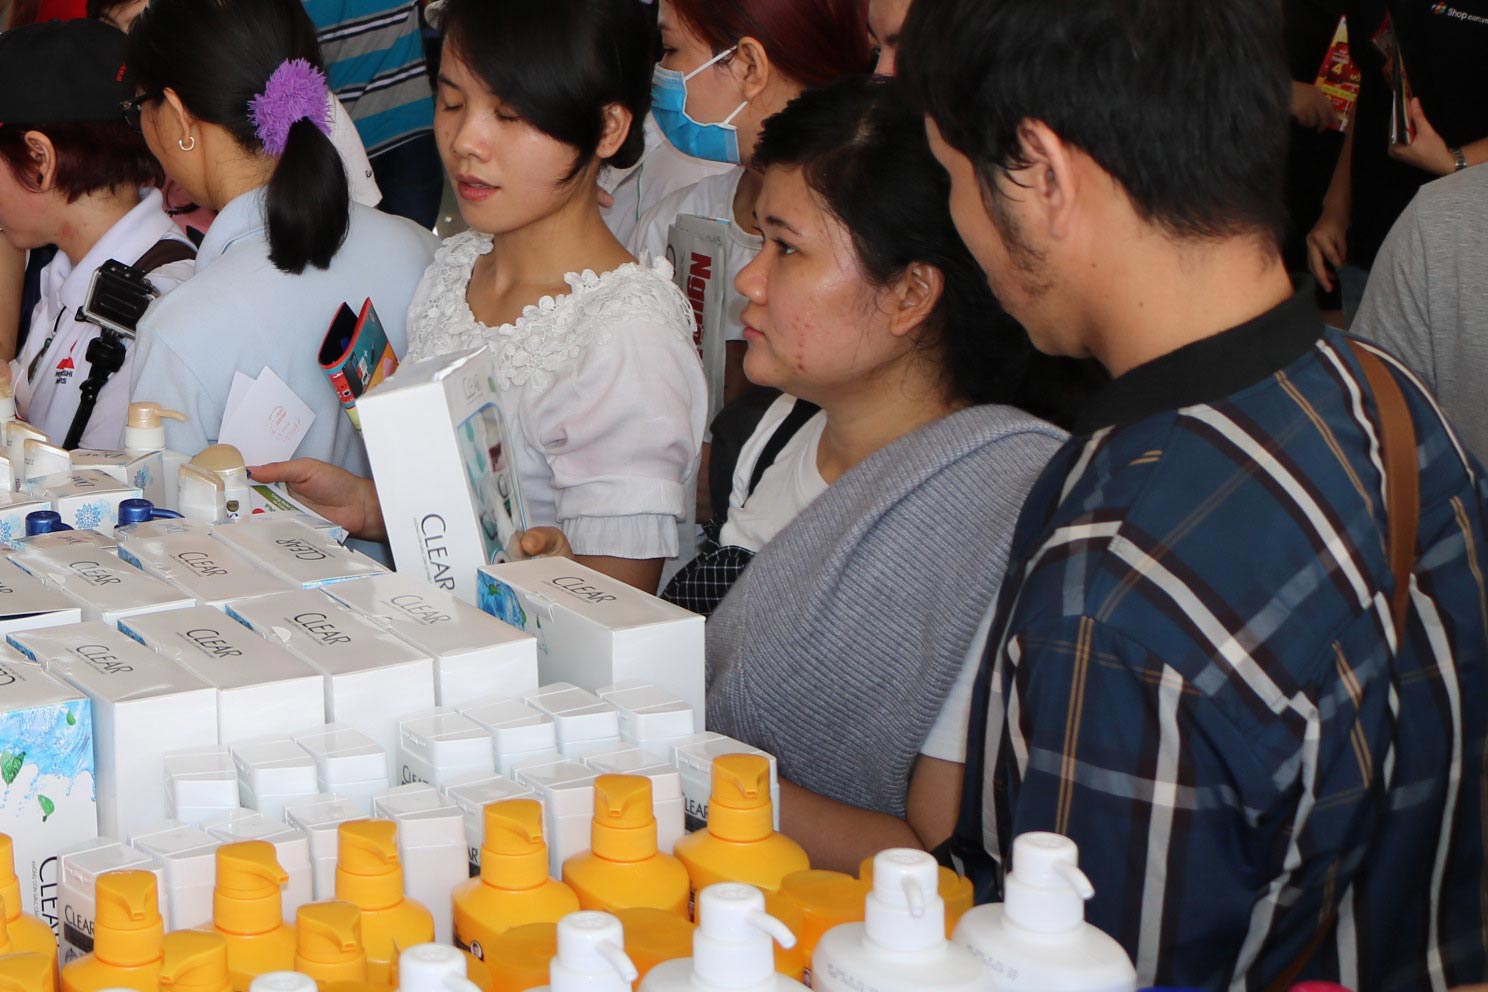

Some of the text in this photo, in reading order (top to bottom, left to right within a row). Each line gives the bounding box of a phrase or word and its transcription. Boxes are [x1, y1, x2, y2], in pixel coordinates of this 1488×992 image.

[178, 551, 228, 578] CLEAR
[276, 537, 327, 562] CLEAR
[421, 512, 456, 592] CLEAR
[69, 560, 122, 587] CLEAR
[551, 575, 617, 604] CLEAR
[390, 593, 452, 625] CLEAR
[186, 628, 243, 659] CLEAR
[294, 612, 352, 647] CLEAR
[76, 644, 134, 675] CLEAR
[684, 793, 708, 818] LEAR
[64, 904, 94, 935] CLEAR
